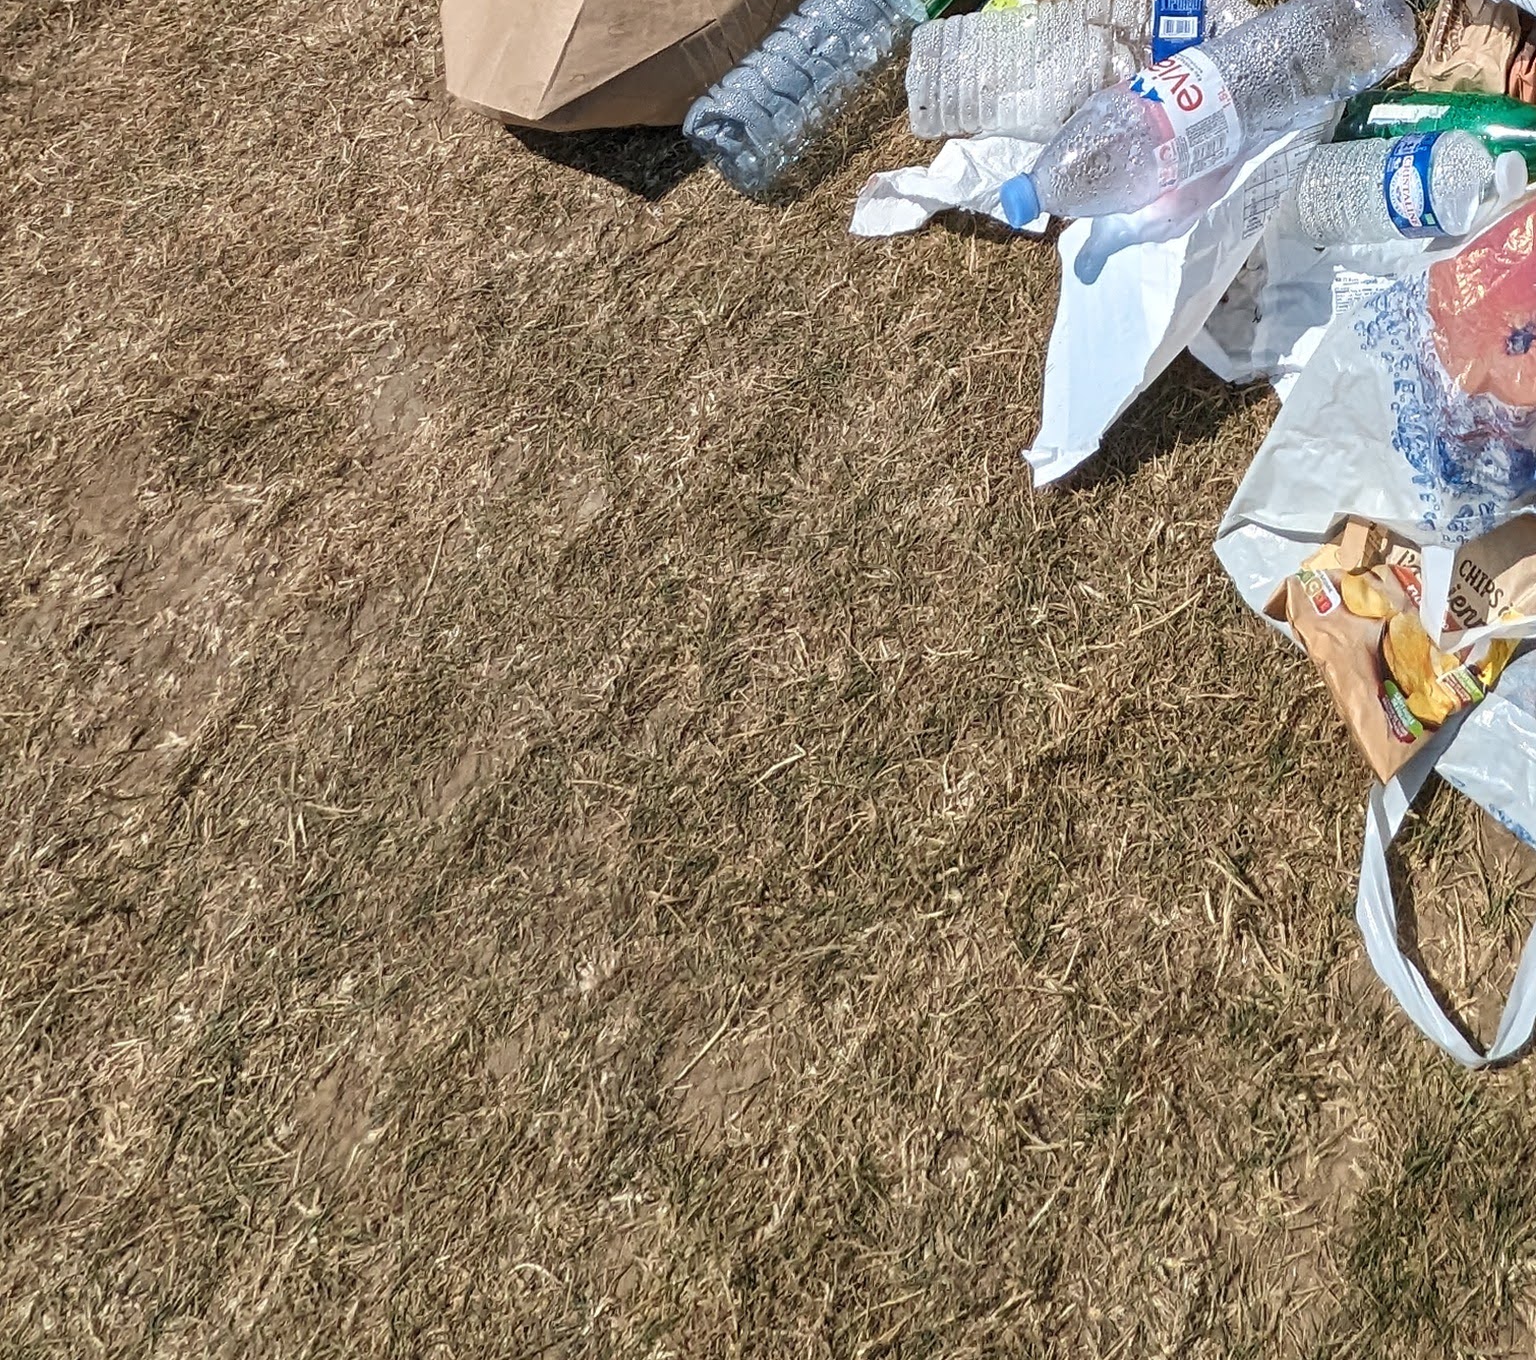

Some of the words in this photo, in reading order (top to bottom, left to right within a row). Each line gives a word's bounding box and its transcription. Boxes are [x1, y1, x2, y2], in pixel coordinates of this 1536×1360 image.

[1148, 58, 1203, 112] evia
[1402, 156, 1421, 226] CRISTALINE
[1459, 559, 1504, 608] CHIPS
